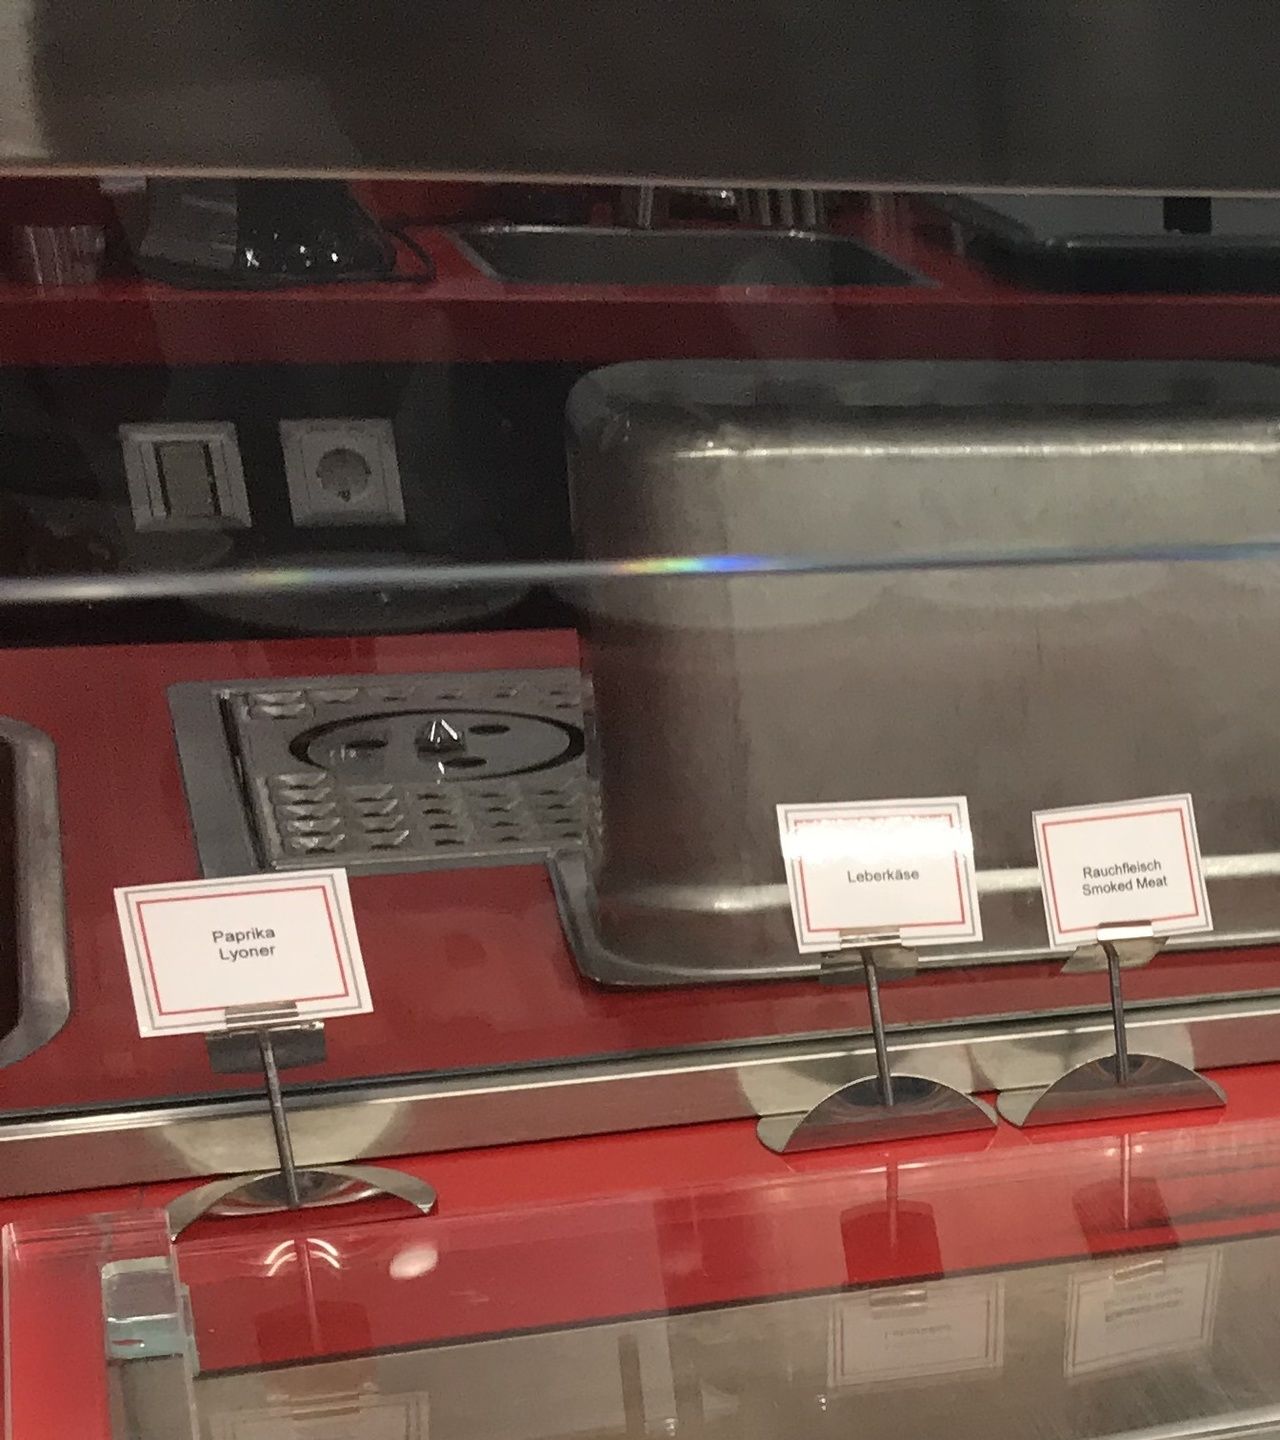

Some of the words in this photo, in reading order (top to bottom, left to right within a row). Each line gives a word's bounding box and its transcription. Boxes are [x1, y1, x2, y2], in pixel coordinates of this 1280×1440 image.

[847, 869, 919, 883] Leberkäse
[1083, 859, 1161, 879] Rauchfleisch
[1083, 880, 1133, 896] Smoked
[1137, 876, 1167, 889] Meat
[212, 927, 275, 943] Paprika
[219, 944, 276, 962] Lyoner
